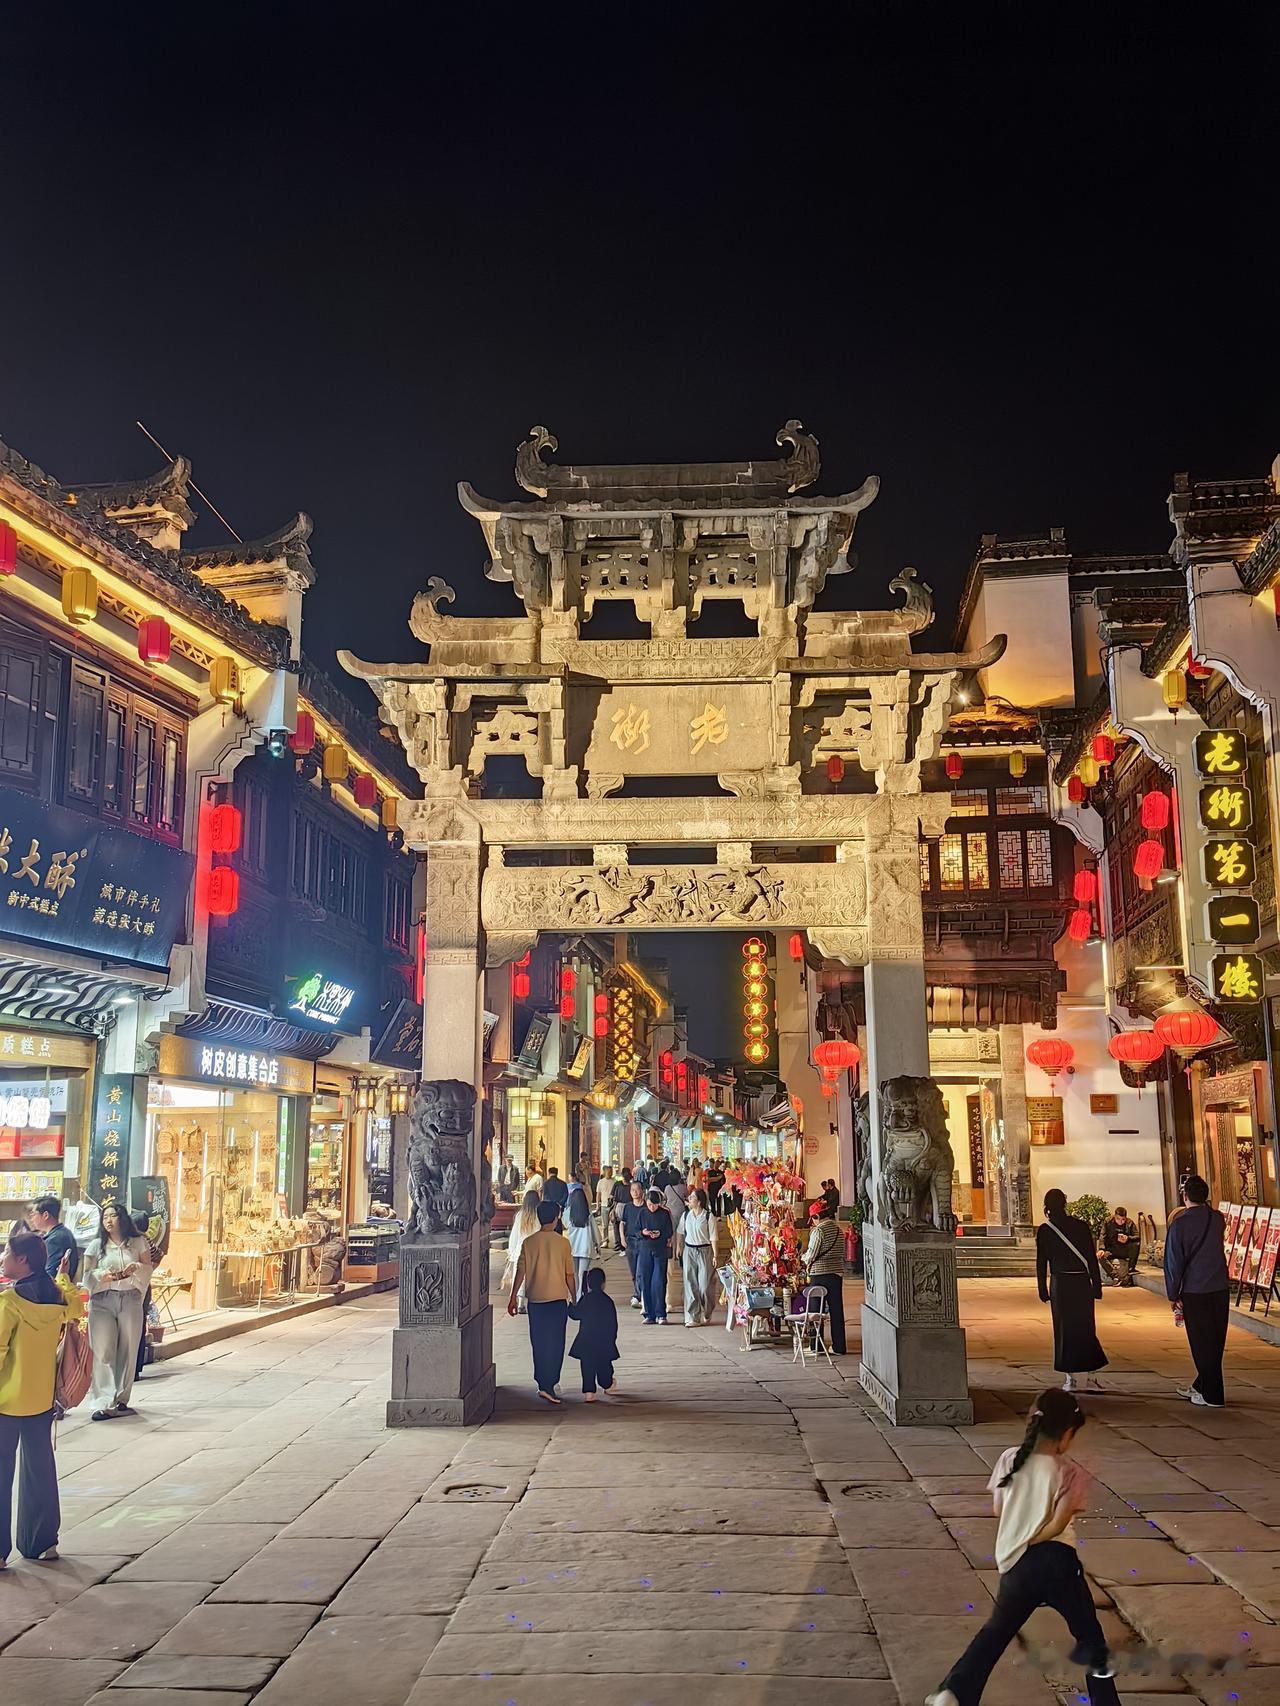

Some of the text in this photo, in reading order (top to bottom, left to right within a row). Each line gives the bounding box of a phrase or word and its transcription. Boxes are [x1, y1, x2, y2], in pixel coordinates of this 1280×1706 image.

[7, 889, 60, 917] 新中式糕点
[201, 1045, 280, 1085] 树皮创意集合店
